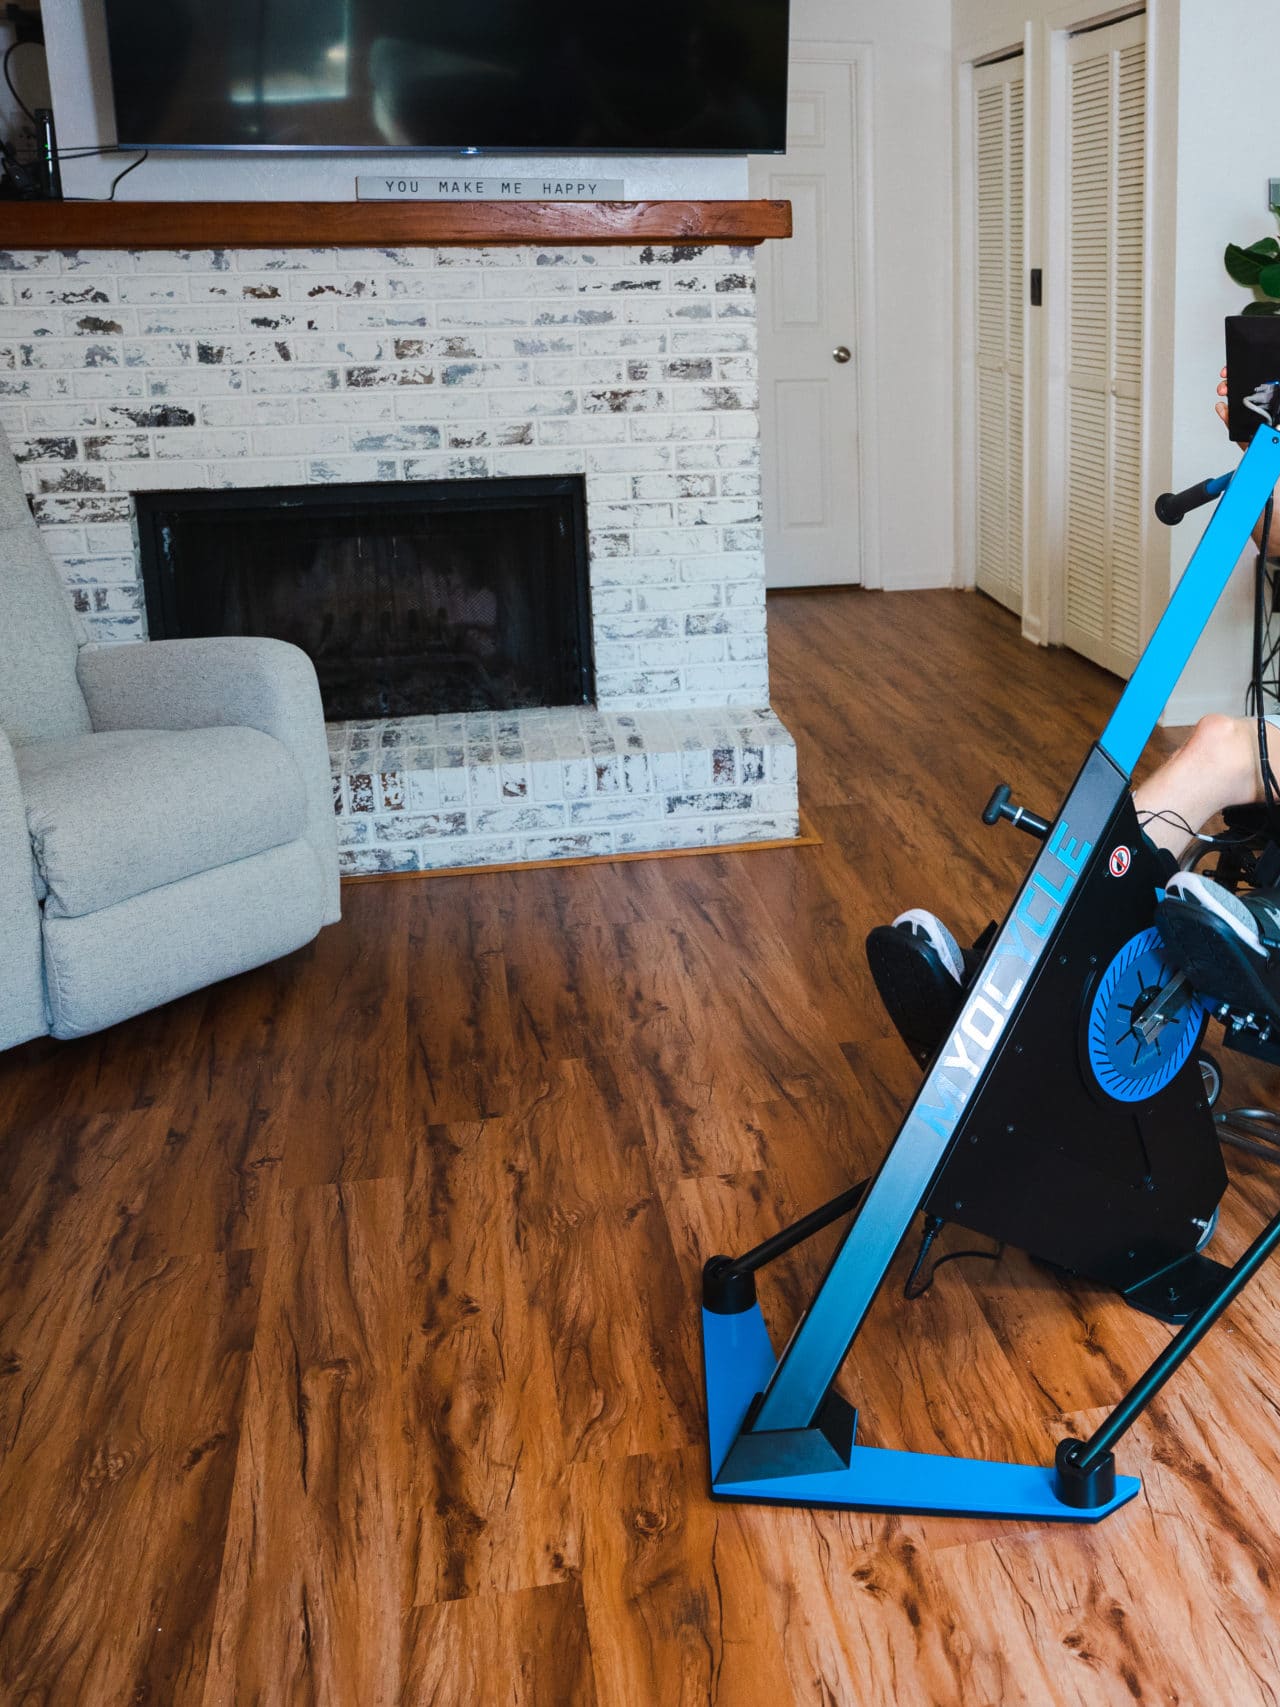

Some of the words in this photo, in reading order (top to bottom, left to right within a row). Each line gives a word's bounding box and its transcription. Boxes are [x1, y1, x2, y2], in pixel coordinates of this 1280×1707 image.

[385, 180, 419, 193] YOU
[438, 181, 484, 194] MAKE
[501, 182, 523, 194] ME
[542, 182, 598, 195] HAPPY
[917, 821, 1092, 1137] MYOCYCLE
